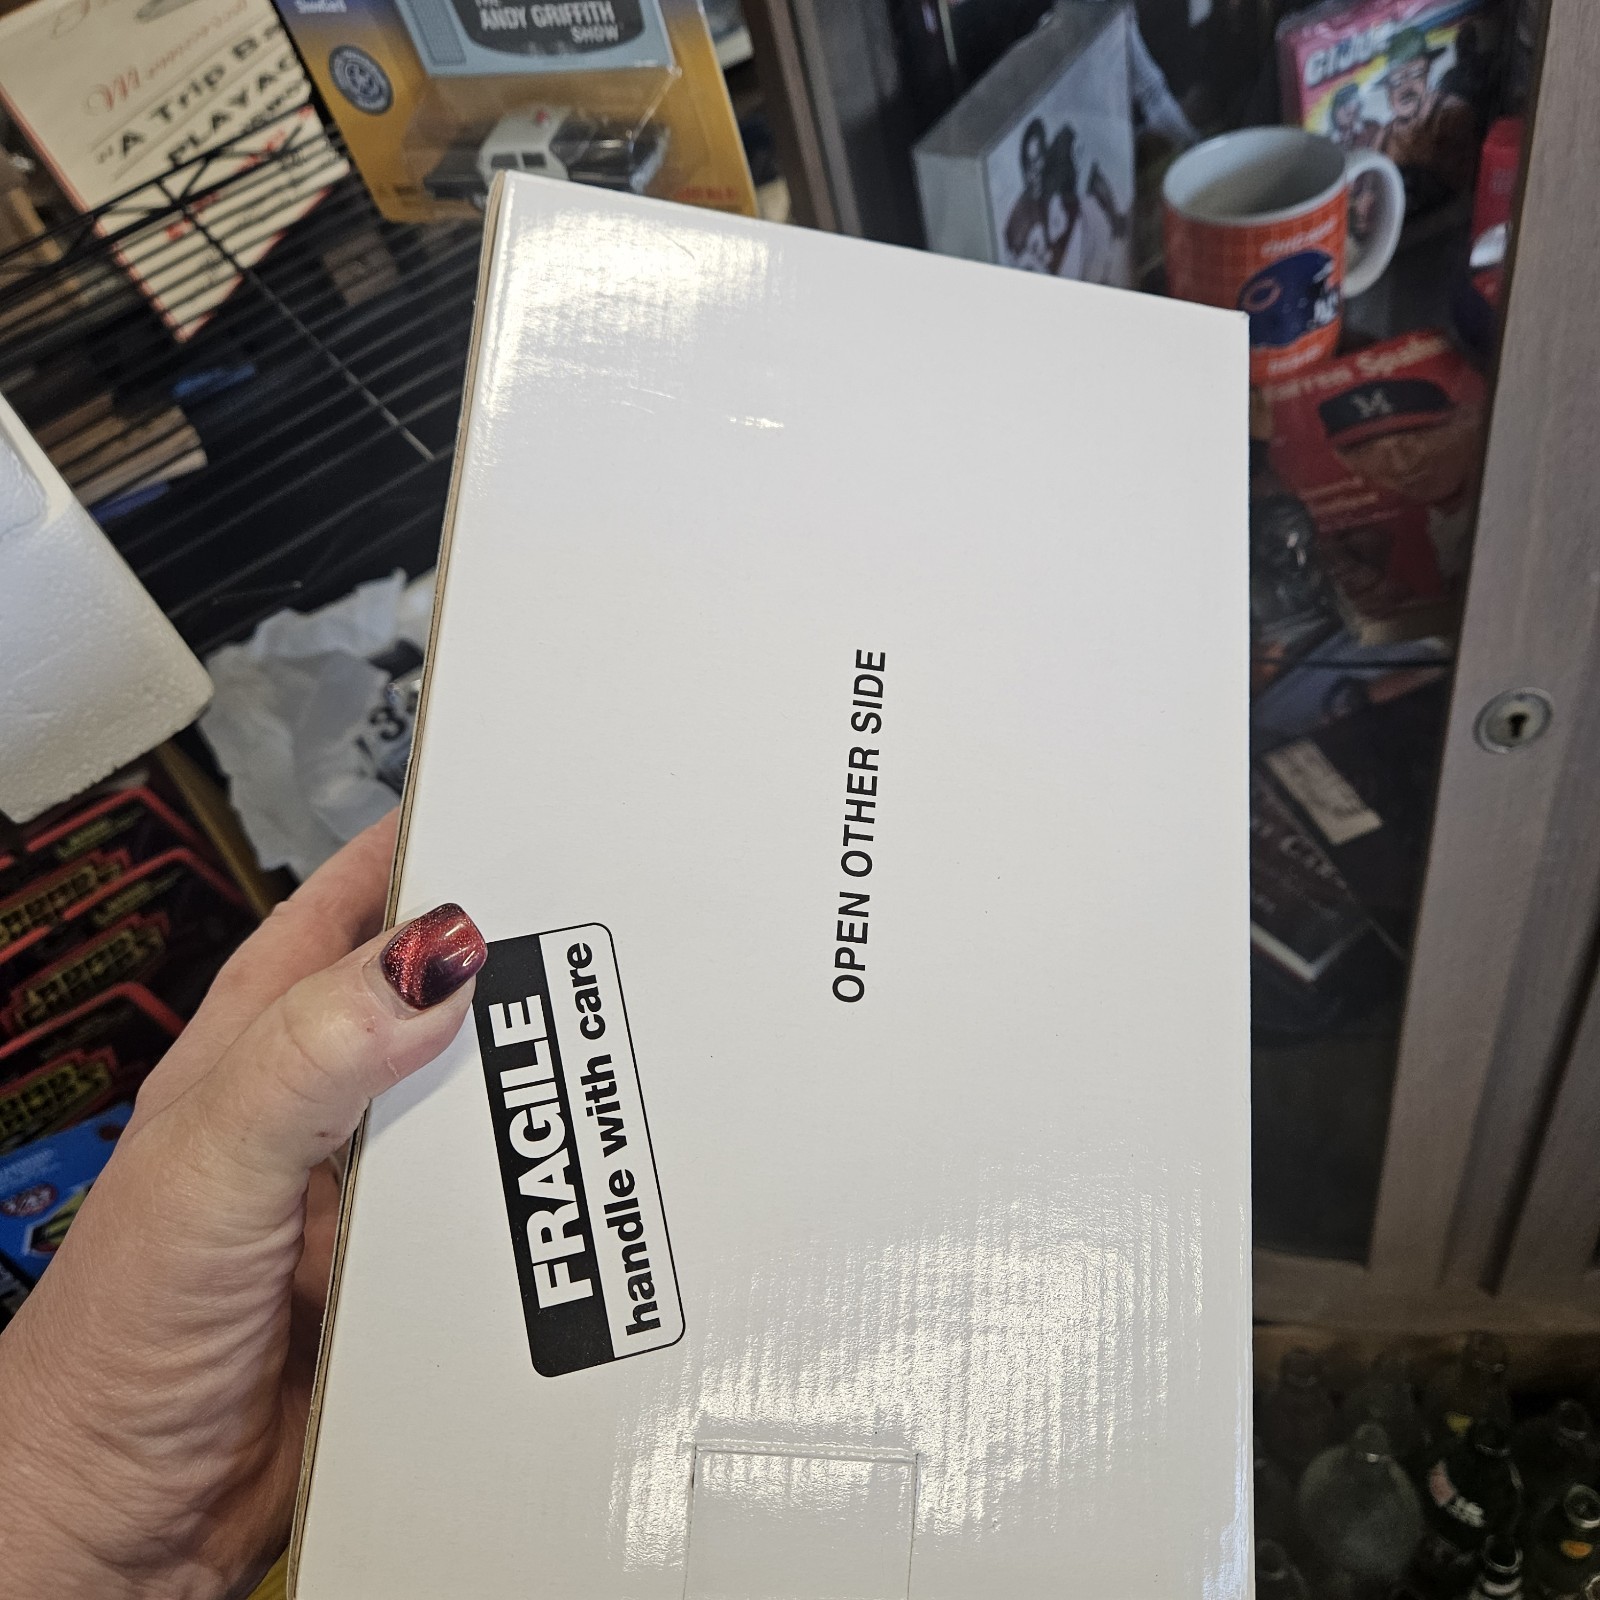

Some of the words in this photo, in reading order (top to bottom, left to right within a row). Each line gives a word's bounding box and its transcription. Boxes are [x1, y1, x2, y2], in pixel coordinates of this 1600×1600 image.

[480, 6, 527, 31] ANDY
[530, 1, 616, 28] GRIFFITH
[571, 24, 619, 44] SHOW
[150, 63, 226, 124] Trip
[850, 649, 886, 734] SIDE
[841, 746, 880, 877] OTHER
[567, 942, 606, 1040] care
[832, 891, 870, 1003] OPEN
[488, 994, 594, 1308] FRAGILE
[580, 1053, 630, 1158] with
[605, 1168, 661, 1336] handle
